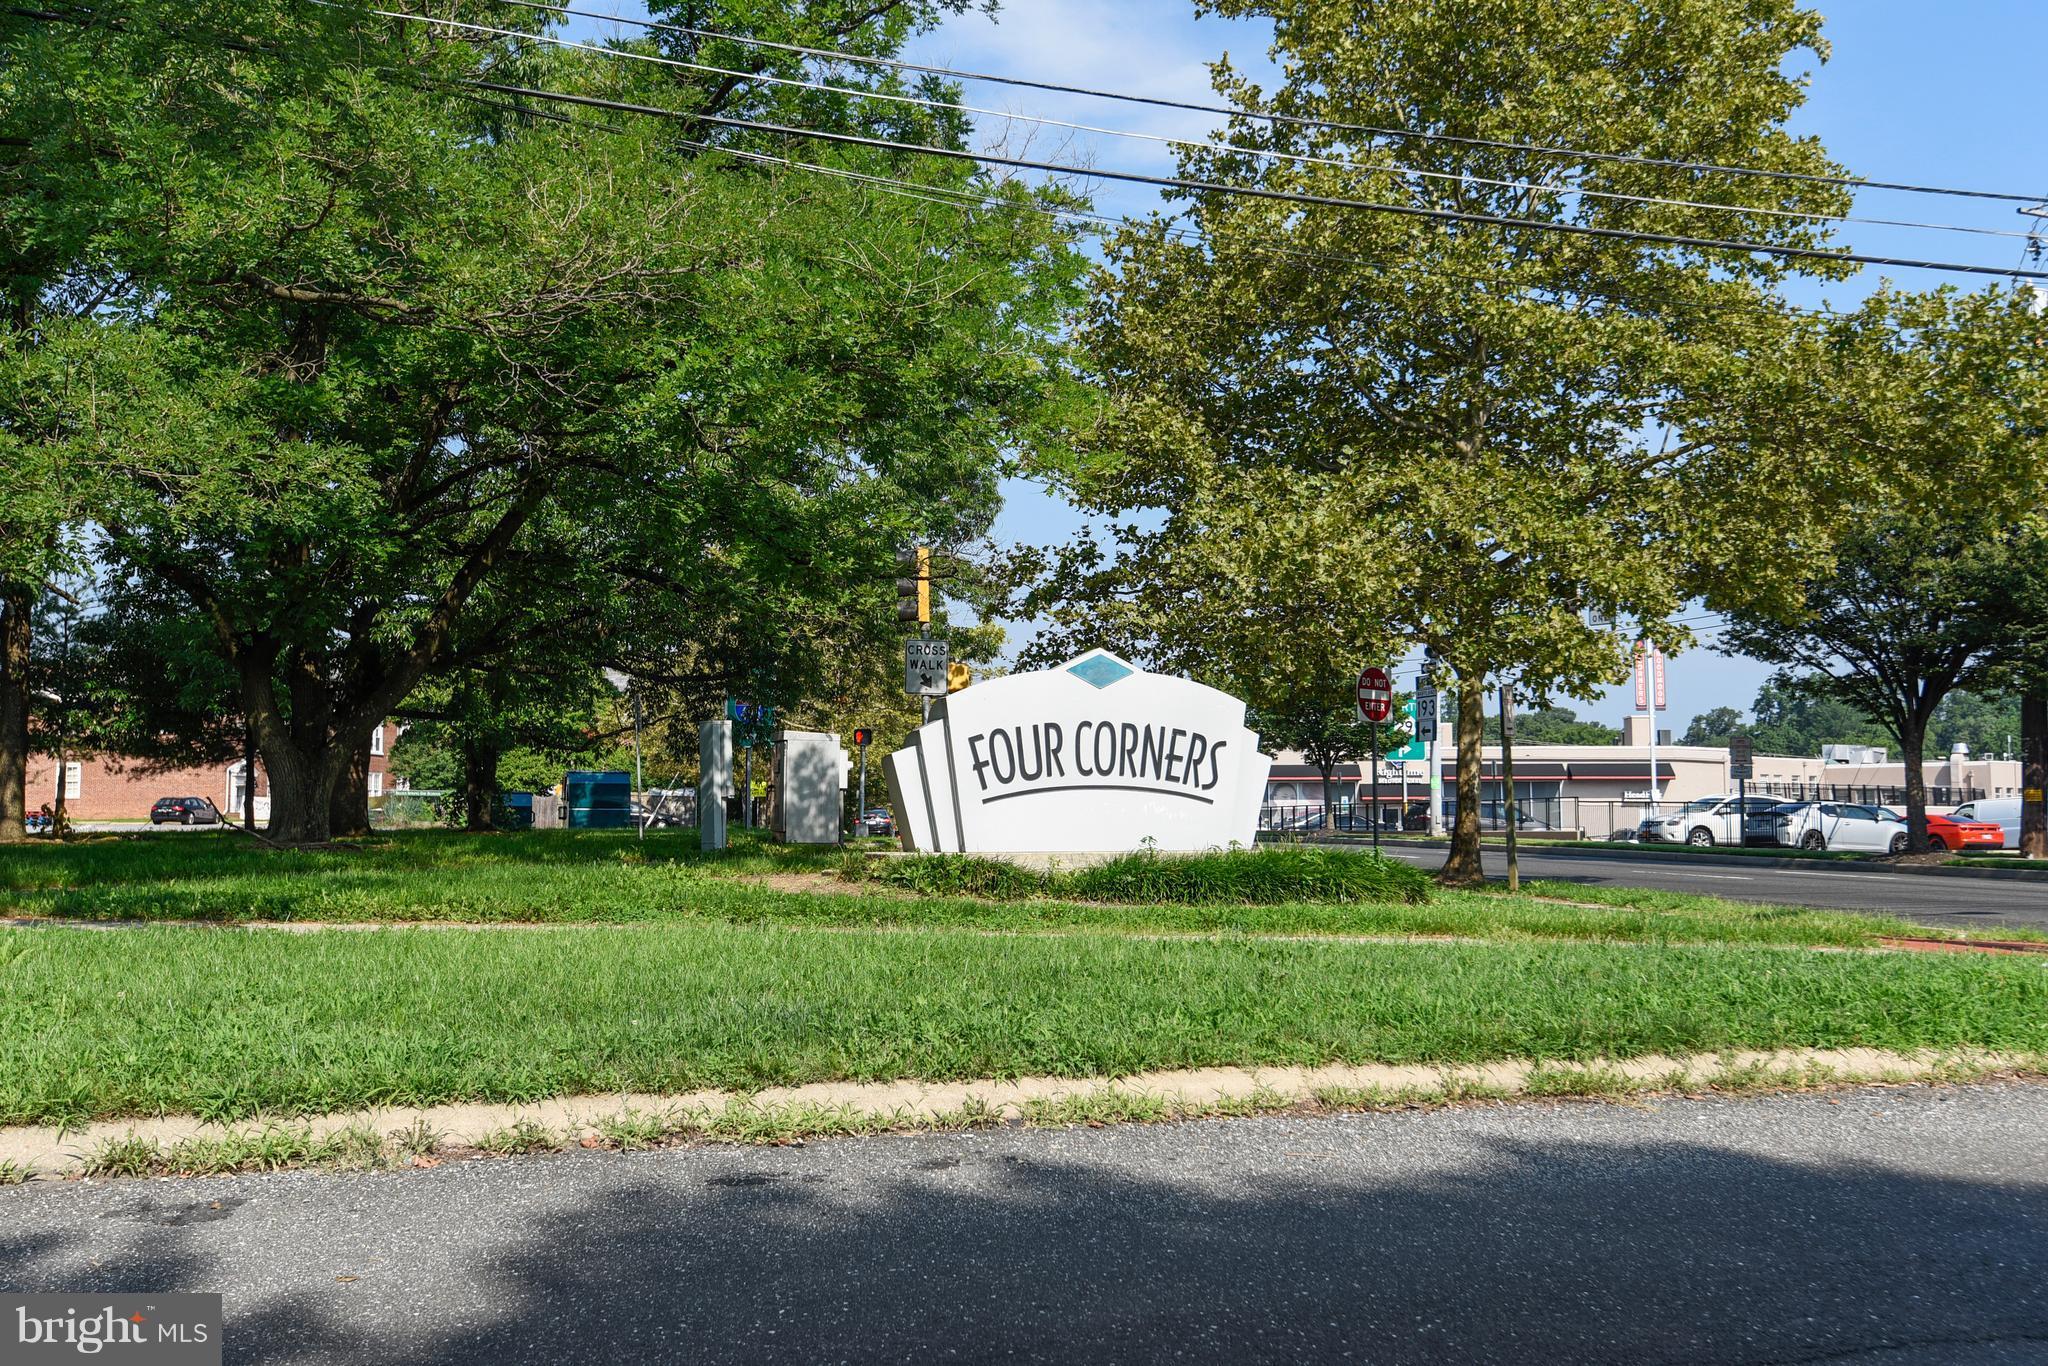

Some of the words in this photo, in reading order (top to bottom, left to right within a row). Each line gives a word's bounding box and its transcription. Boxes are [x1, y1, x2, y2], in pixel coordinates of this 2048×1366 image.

[908, 645, 946, 656] CROSS
[910, 659, 943, 670] WALK
[1361, 677, 1371, 687] DO
[1374, 679, 1387, 688] NOT
[1364, 702, 1386, 712] ENTER
[1417, 699, 1435, 716] 193
[968, 722, 1065, 790] FOUR
[1075, 720, 1227, 790] CORNERS
